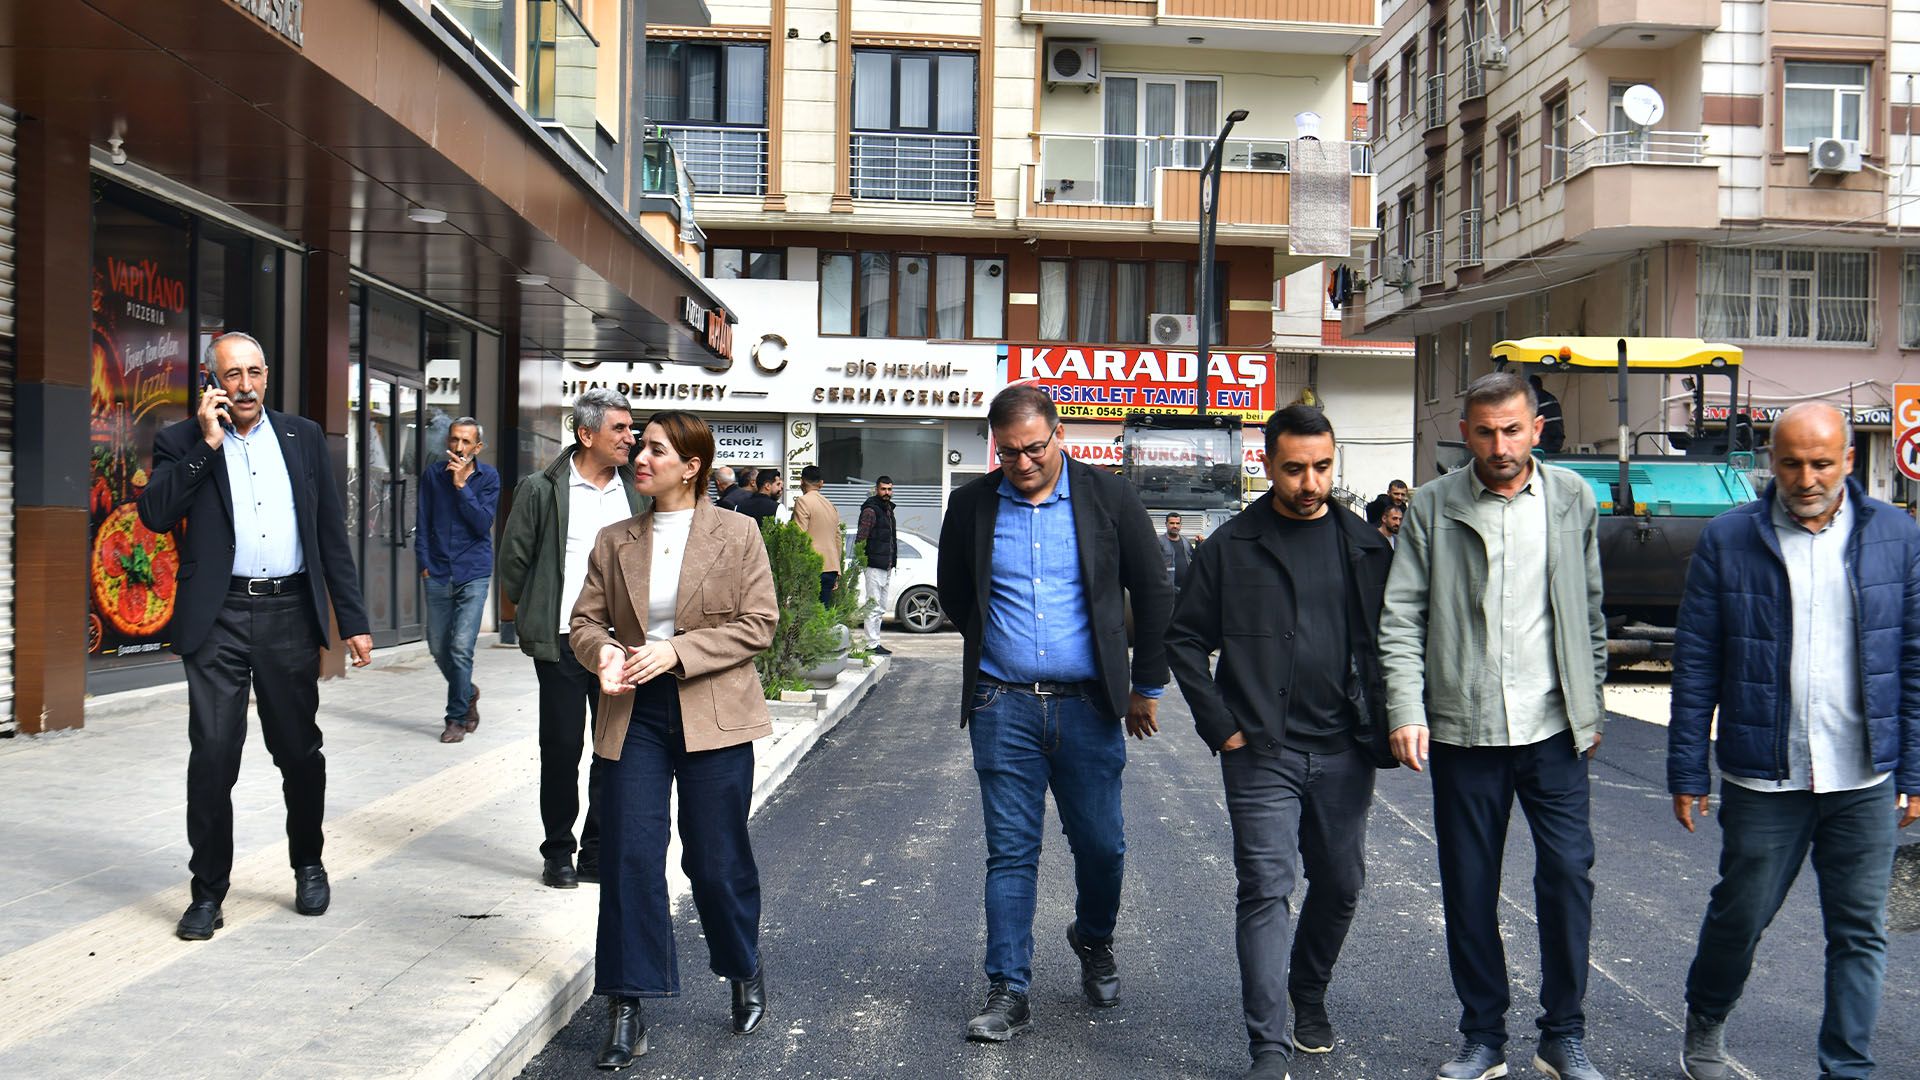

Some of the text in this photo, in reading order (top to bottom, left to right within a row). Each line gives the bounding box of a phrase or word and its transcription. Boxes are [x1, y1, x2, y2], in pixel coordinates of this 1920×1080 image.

[126, 301, 165, 326] PIZZERIA
[846, 358, 952, 379] DİŞ HEKİMİ
[1020, 347, 1267, 388] KARADAŞ
[617, 382, 728, 398] DENTISTRY
[813, 387, 984, 405] SERHAT CENGİZ
[1061, 406, 1093, 416] USTA:
[1096, 407, 1123, 416] 0545
[717, 423, 758, 434] HEKİMİ
[719, 436, 764, 447] CENGİZ
[717, 450, 764, 459] 564 72 21
